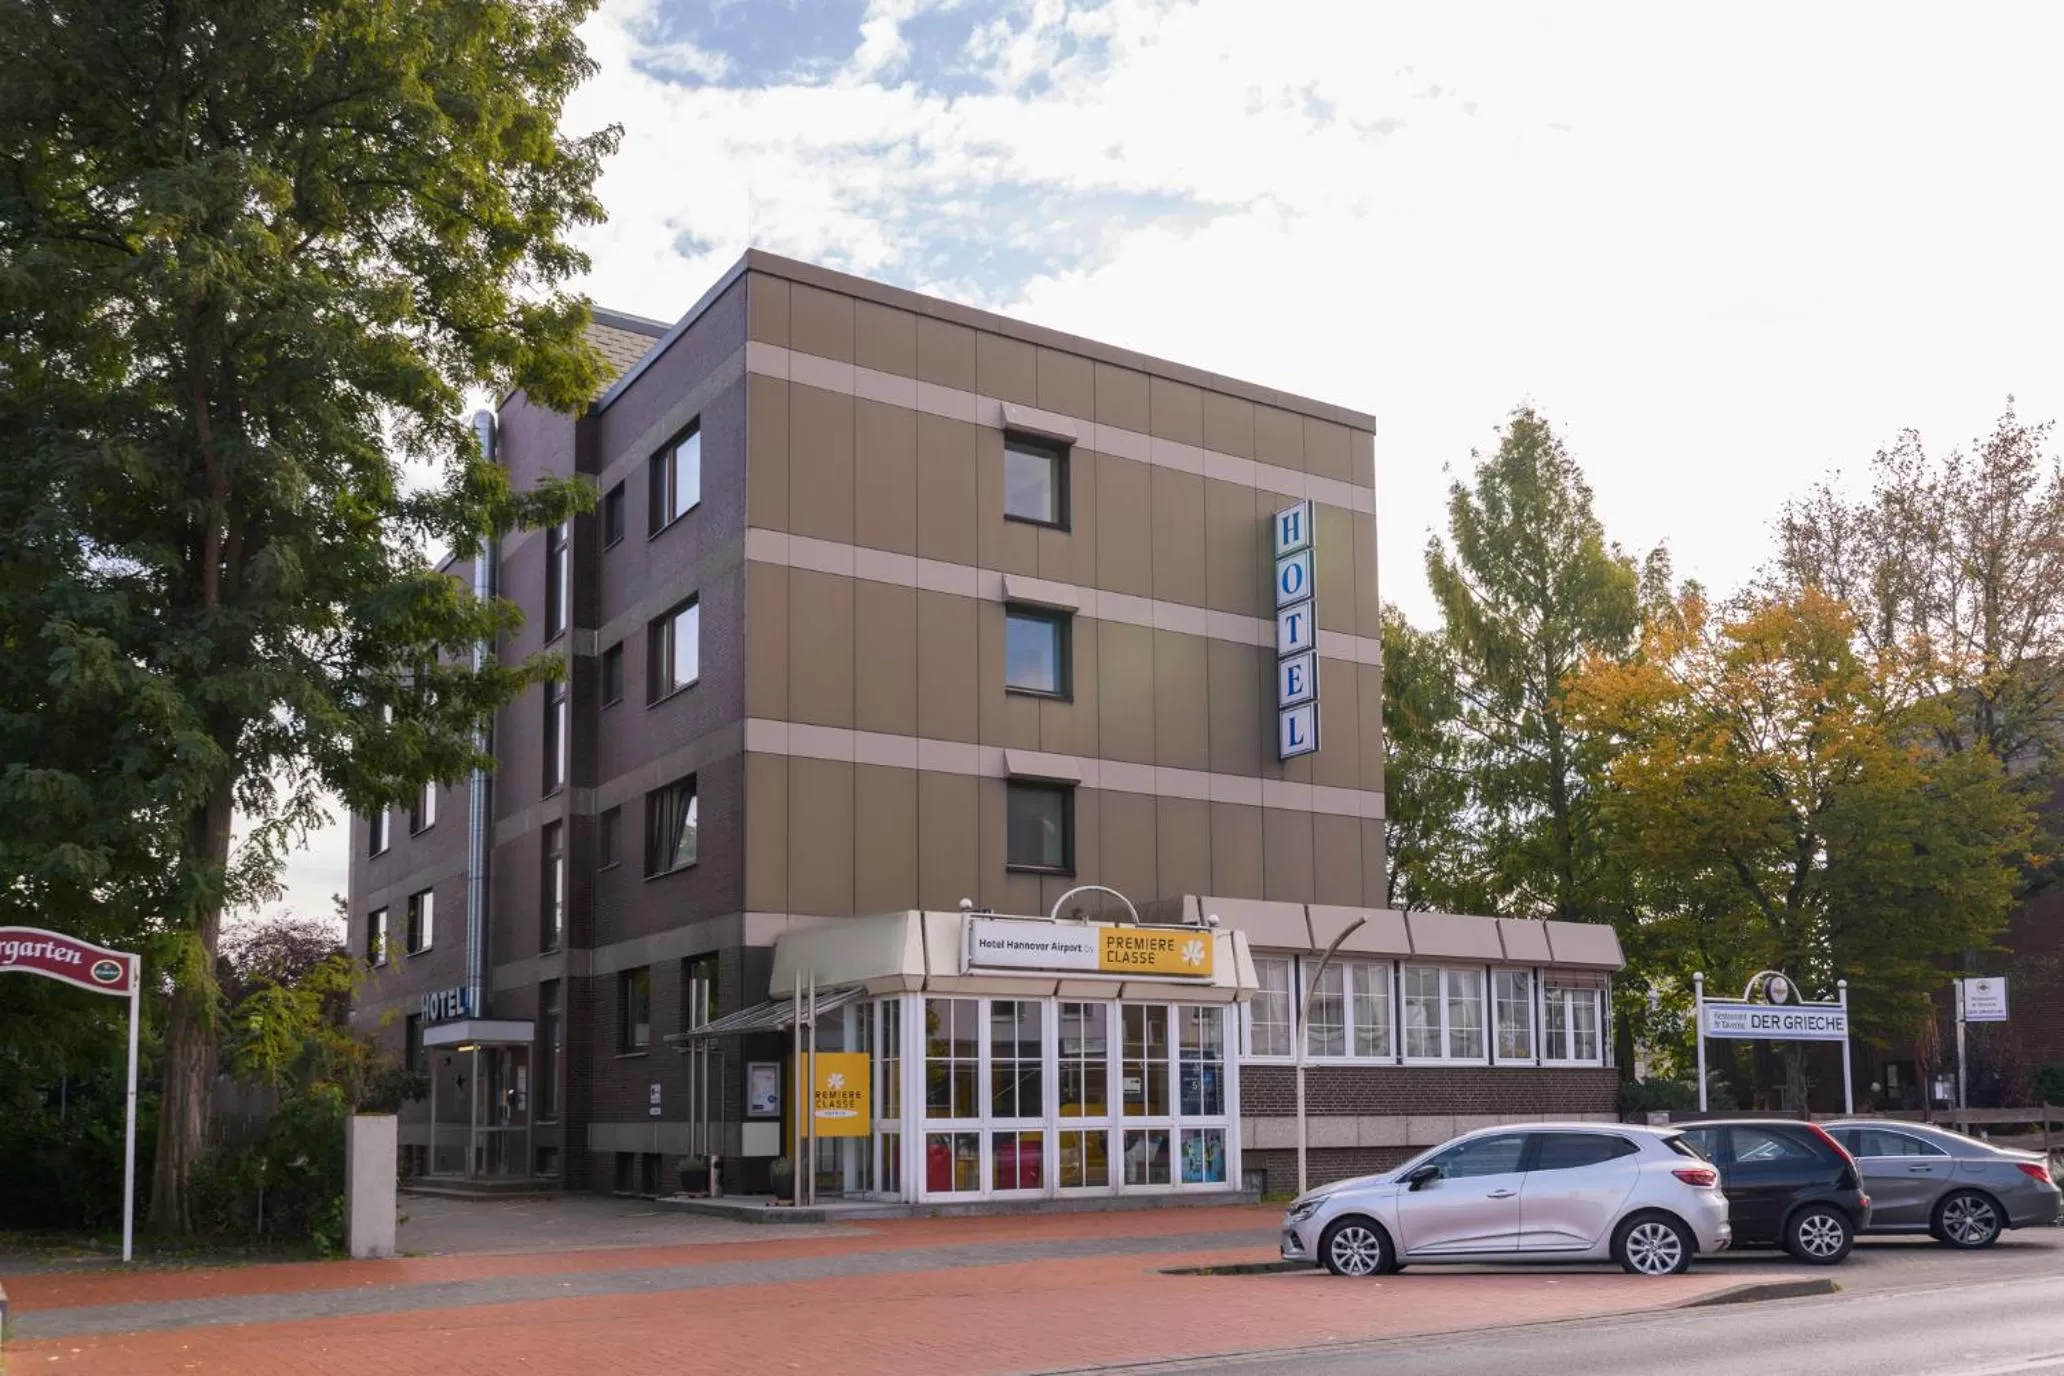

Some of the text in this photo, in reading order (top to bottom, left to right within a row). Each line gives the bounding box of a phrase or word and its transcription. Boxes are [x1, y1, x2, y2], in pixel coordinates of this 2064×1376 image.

[1282, 510, 1304, 747] HOTEL
[979, 939, 1005, 949] Hotel
[1006, 940, 1050, 952] Hannover
[1051, 941, 1083, 954] Airport
[1107, 936, 1175, 952] PREMIERE
[1107, 950, 1156, 965] CLASSE
[421, 985, 464, 1022] HOTEL
[1751, 1014, 1845, 1032] DER GRIECHE
[814, 1090, 863, 1100] REMIERE
